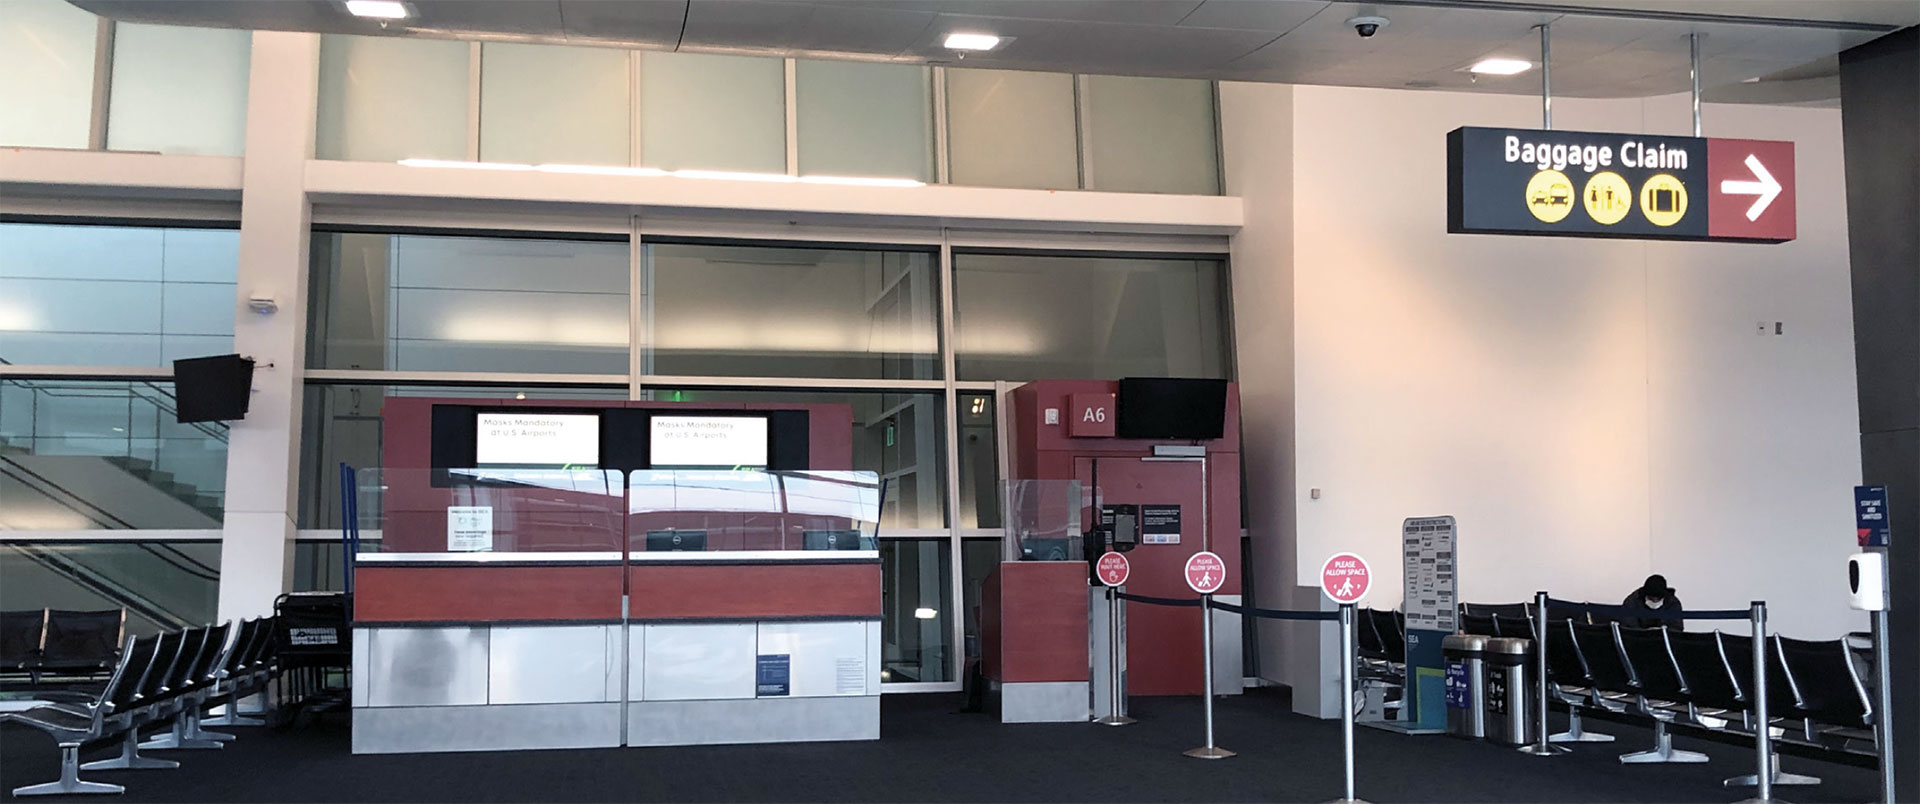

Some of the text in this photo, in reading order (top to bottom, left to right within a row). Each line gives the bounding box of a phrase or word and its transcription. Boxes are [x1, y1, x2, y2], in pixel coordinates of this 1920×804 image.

[1505, 135, 1688, 173] Baggage Claim
[1083, 407, 1105, 422] A6
[515, 419, 564, 427] Mandatory
[687, 421, 734, 430] Mandatory
[521, 429, 557, 437] Airports
[1335, 560, 1356, 568] PLEASE
[1326, 568, 1365, 576] ALLOW SPACE
[1408, 634, 1419, 643] SEA
